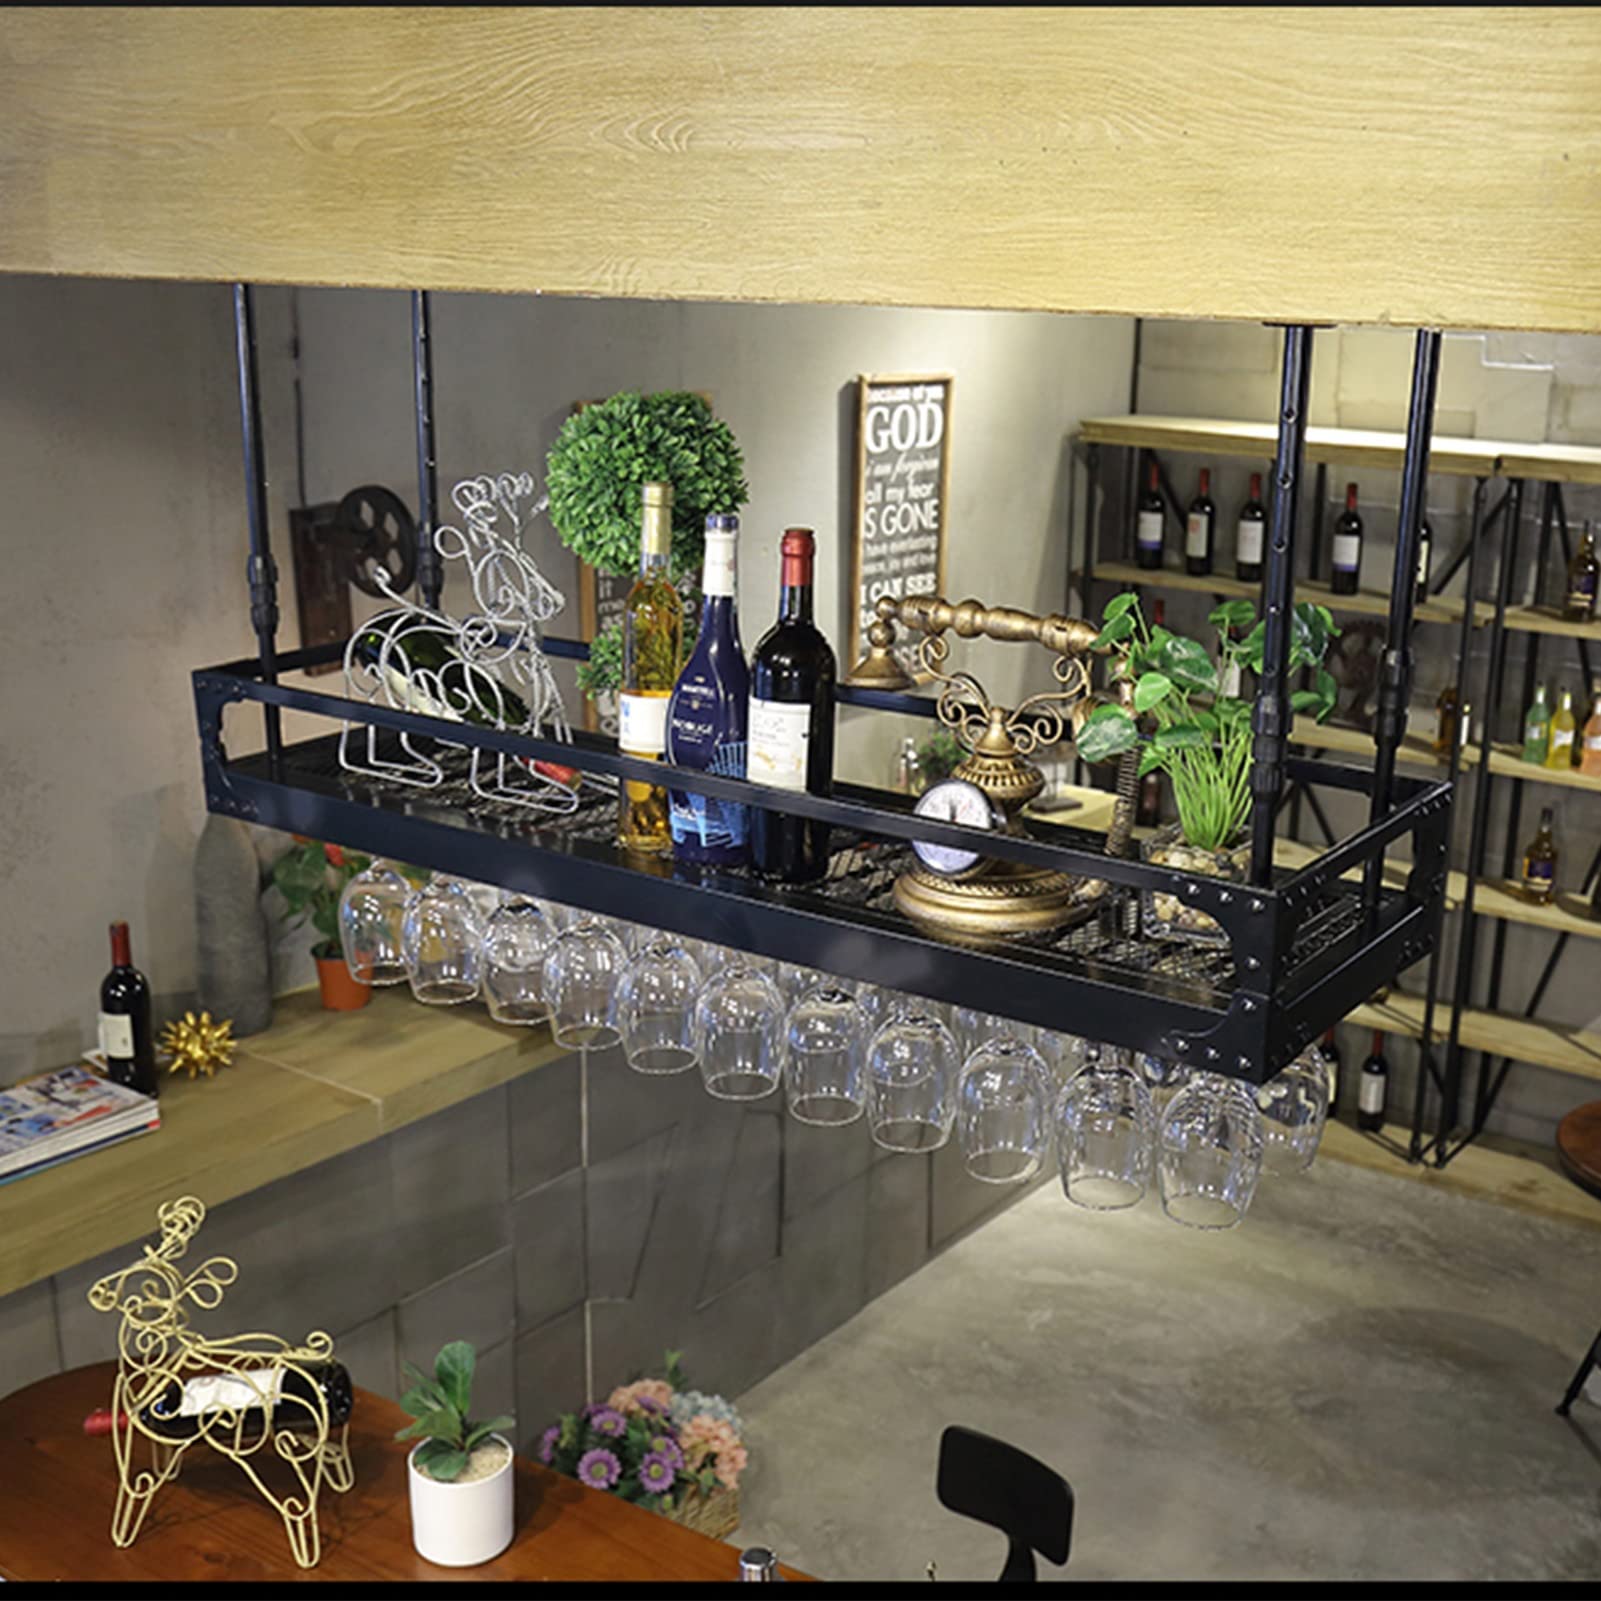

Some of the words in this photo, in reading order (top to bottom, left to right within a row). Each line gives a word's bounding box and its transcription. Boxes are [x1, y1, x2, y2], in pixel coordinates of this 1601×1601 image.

[865, 403, 944, 453] GOD
[886, 487, 905, 504] my
[864, 506, 877, 539] S
[880, 500, 939, 535] GONE
